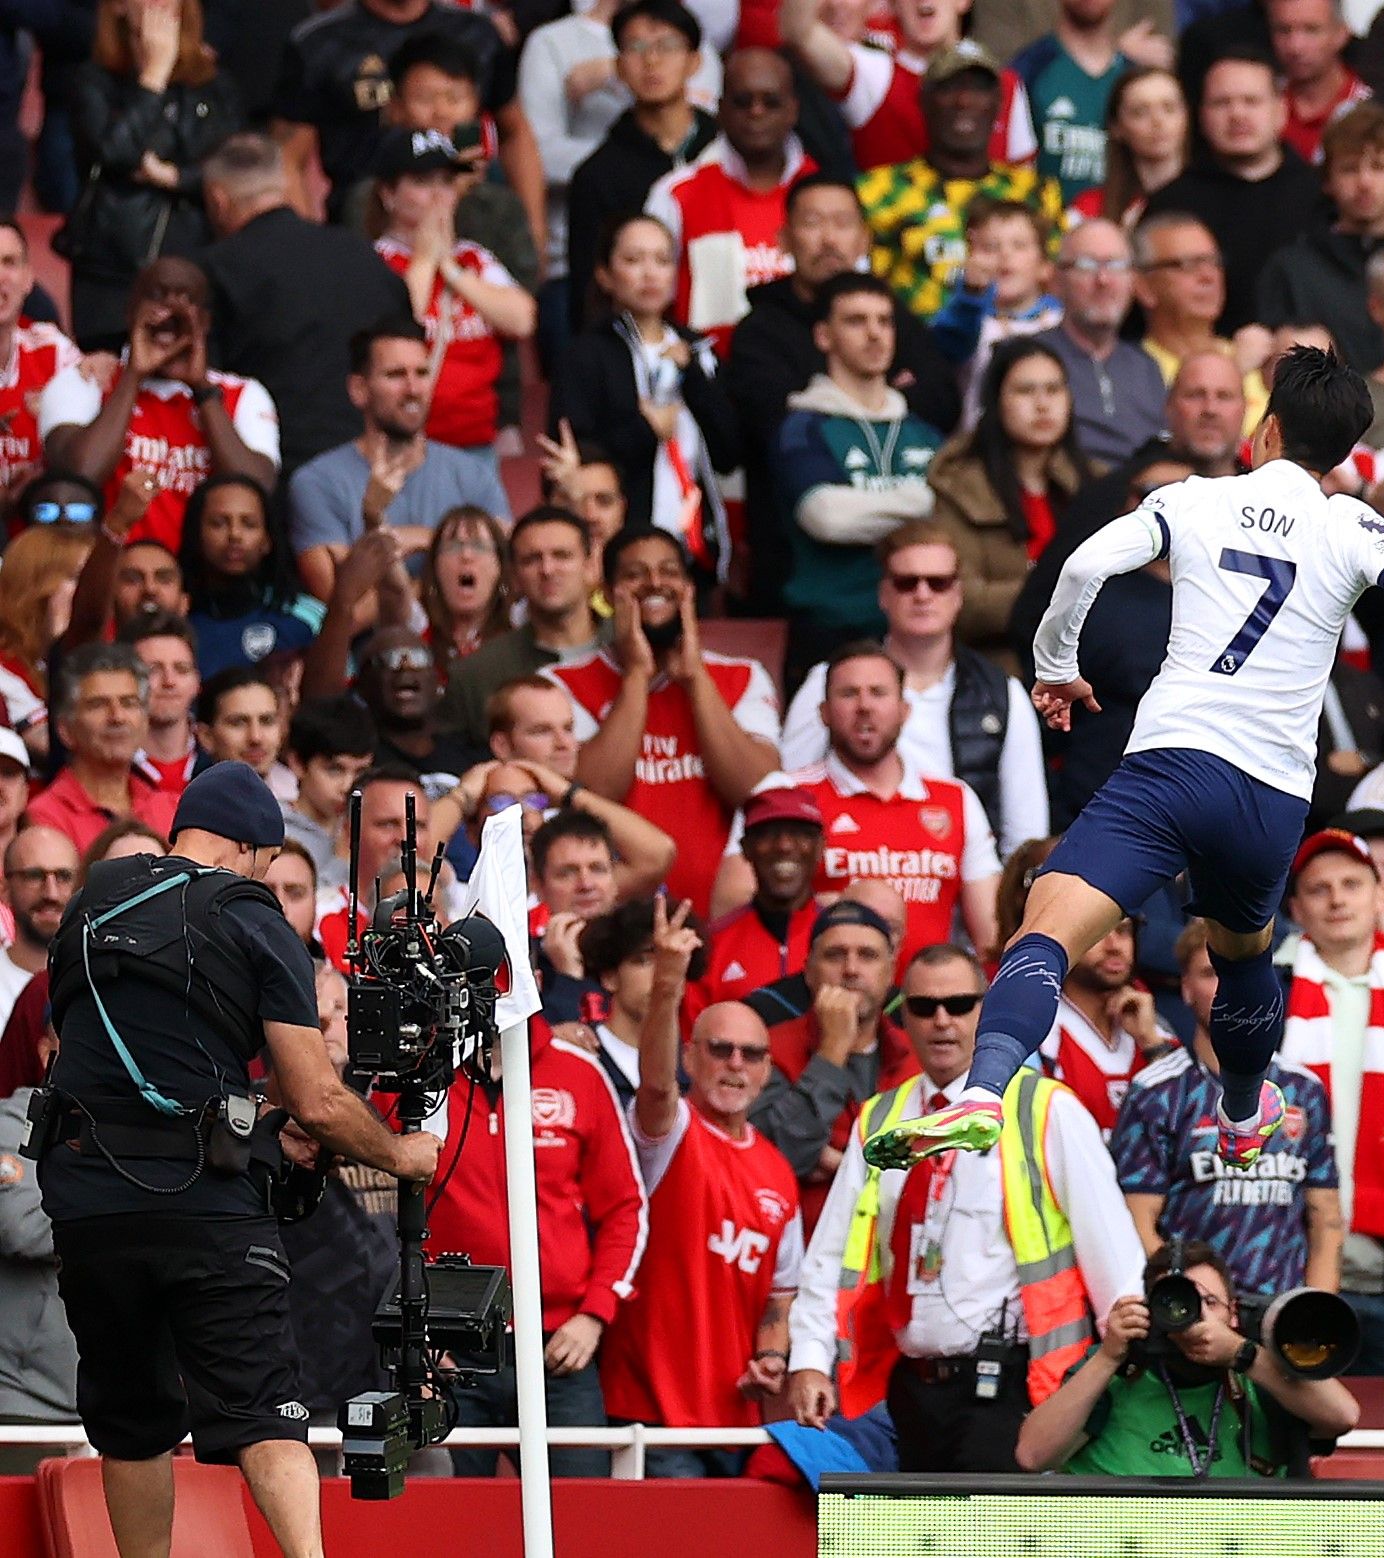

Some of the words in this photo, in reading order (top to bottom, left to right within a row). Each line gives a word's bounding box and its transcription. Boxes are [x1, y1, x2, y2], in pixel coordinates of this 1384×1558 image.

[1240, 506, 1296, 538] SON
[1208, 547, 1298, 677] 7
[707, 1218, 771, 1275] JVC
